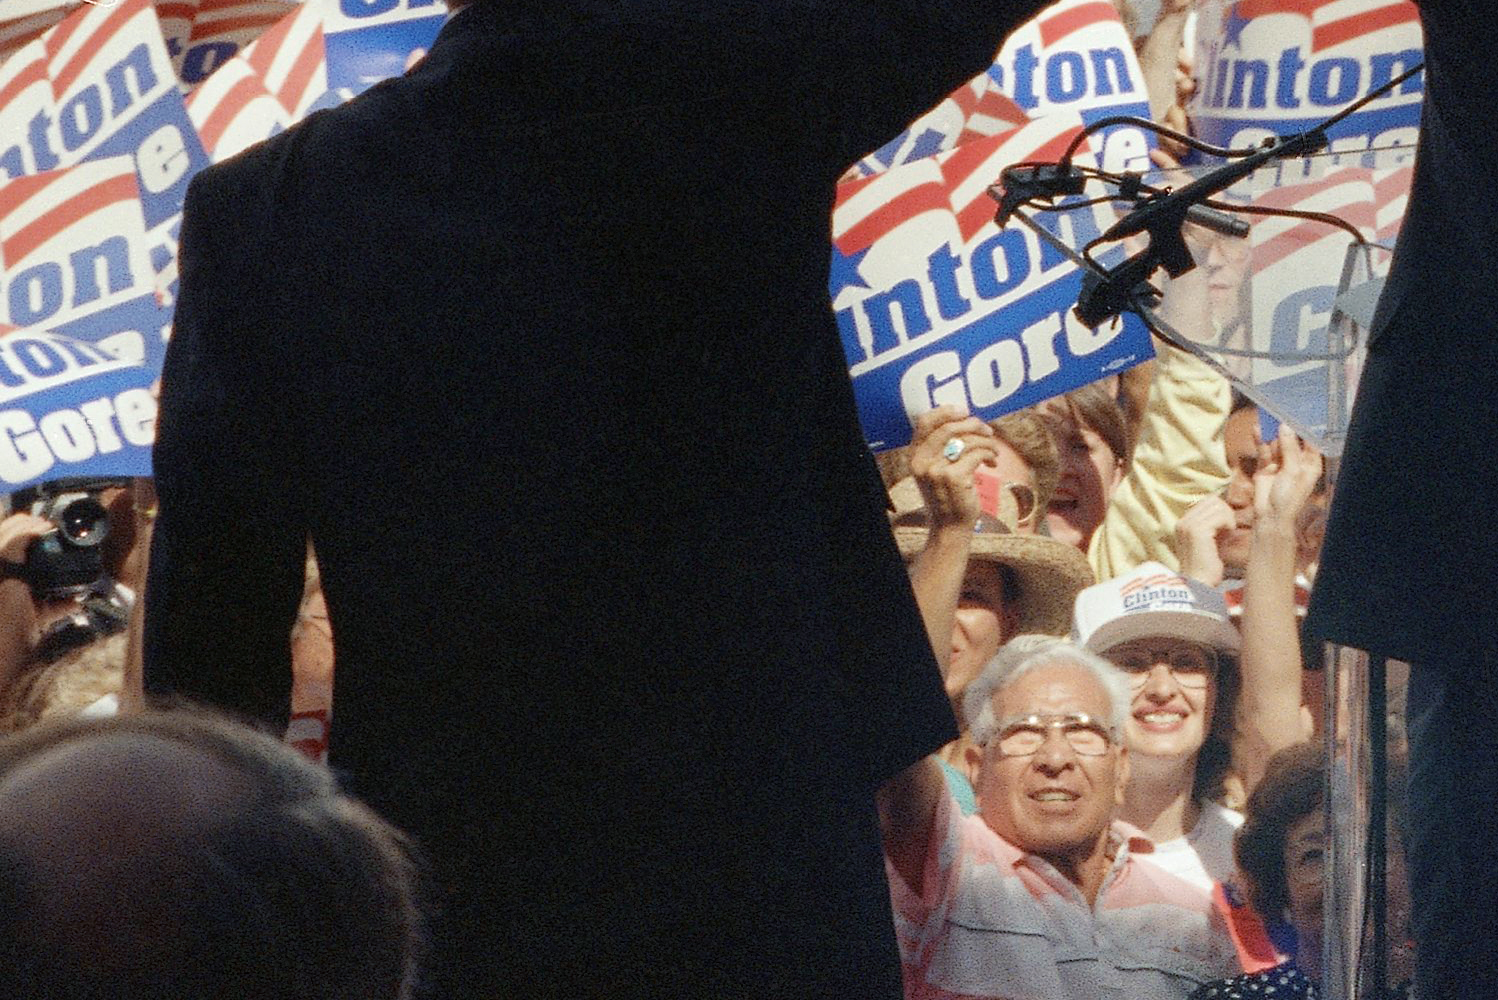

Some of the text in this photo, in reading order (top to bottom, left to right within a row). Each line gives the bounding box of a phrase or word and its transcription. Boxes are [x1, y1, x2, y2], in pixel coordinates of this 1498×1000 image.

[836, 192, 1126, 364] inton
[902, 298, 1123, 417] Gore
[0, 389, 154, 484] Gore
[1122, 588, 1188, 610] Clinton
